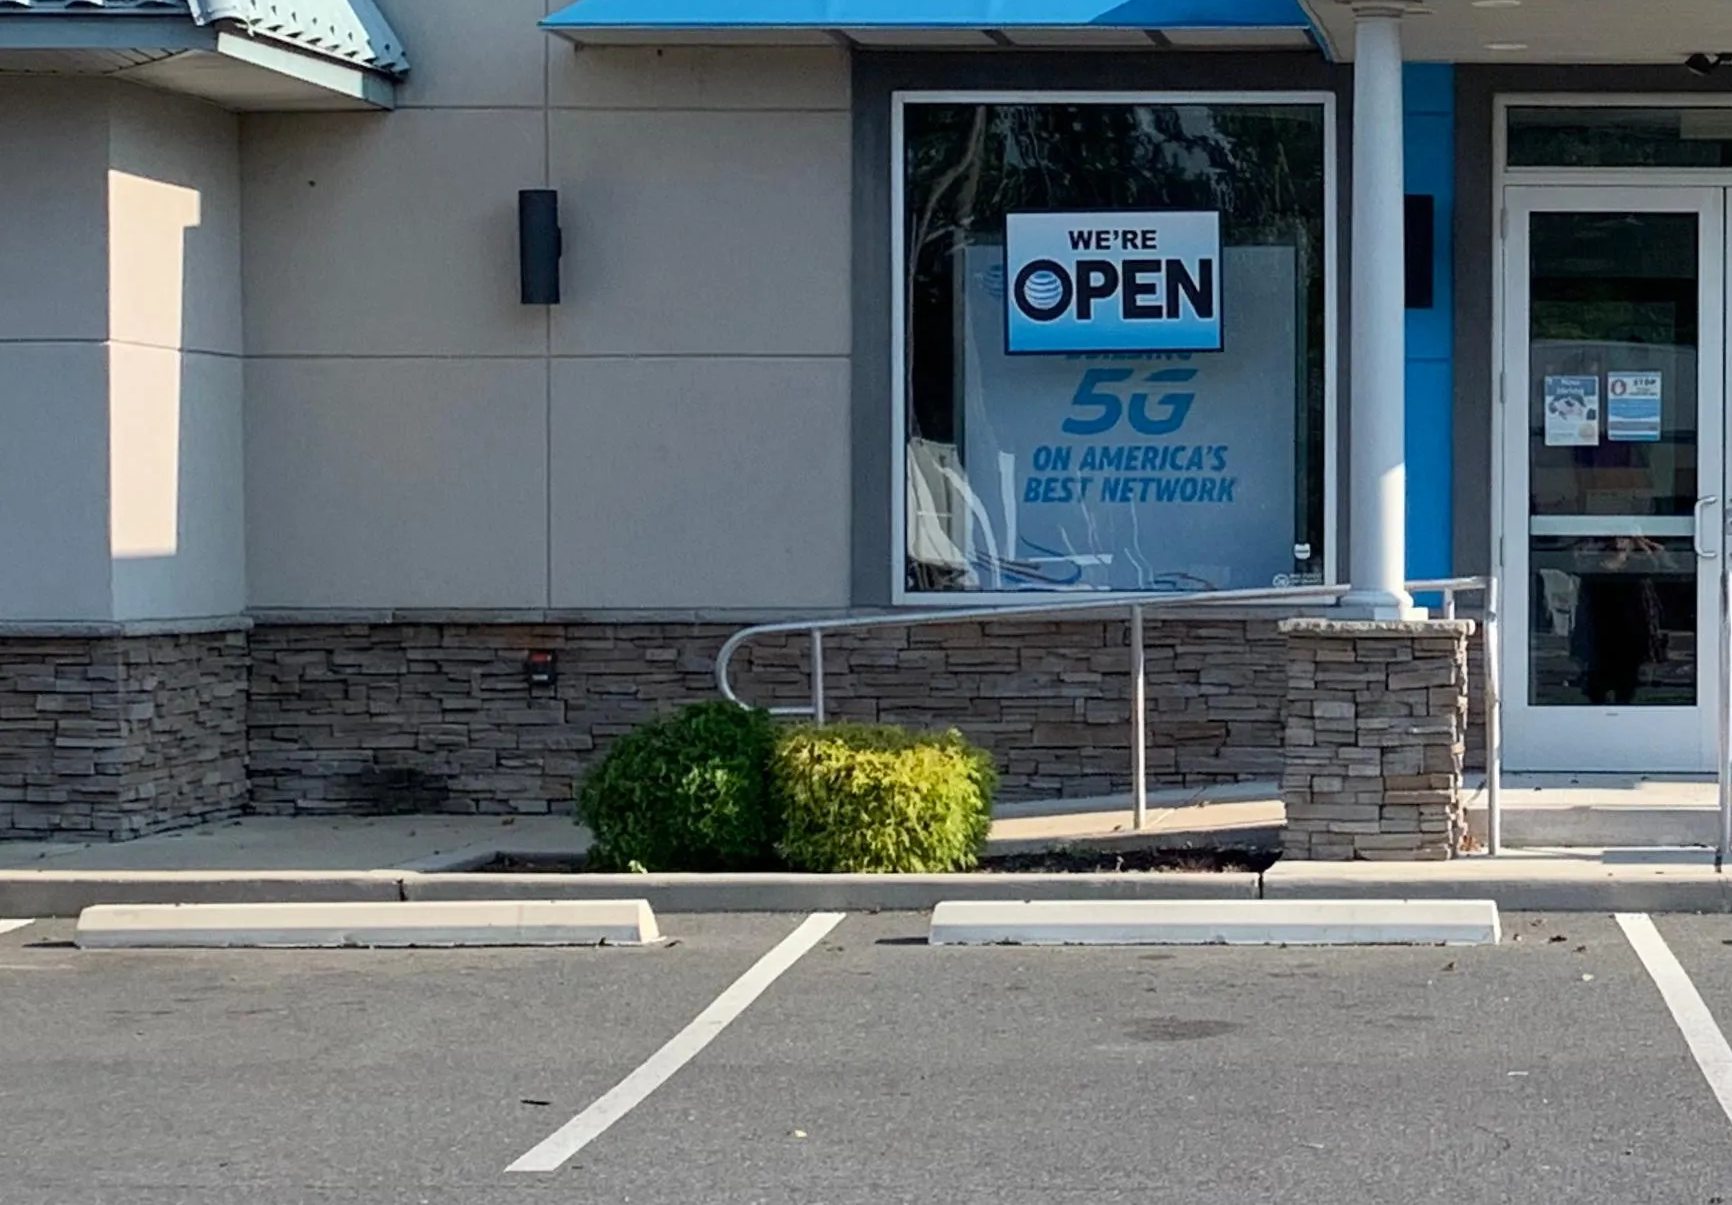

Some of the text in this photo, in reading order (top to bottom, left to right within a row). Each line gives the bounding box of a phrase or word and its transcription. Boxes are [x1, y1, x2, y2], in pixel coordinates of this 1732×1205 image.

[1068, 229, 1157, 250] WE'RE
[1014, 258, 1214, 322] OPEN
[1061, 367, 1199, 436] 5G
[1033, 445, 1228, 472] ON AMERICA'S
[1024, 476, 1239, 503] BEST NETWORK
